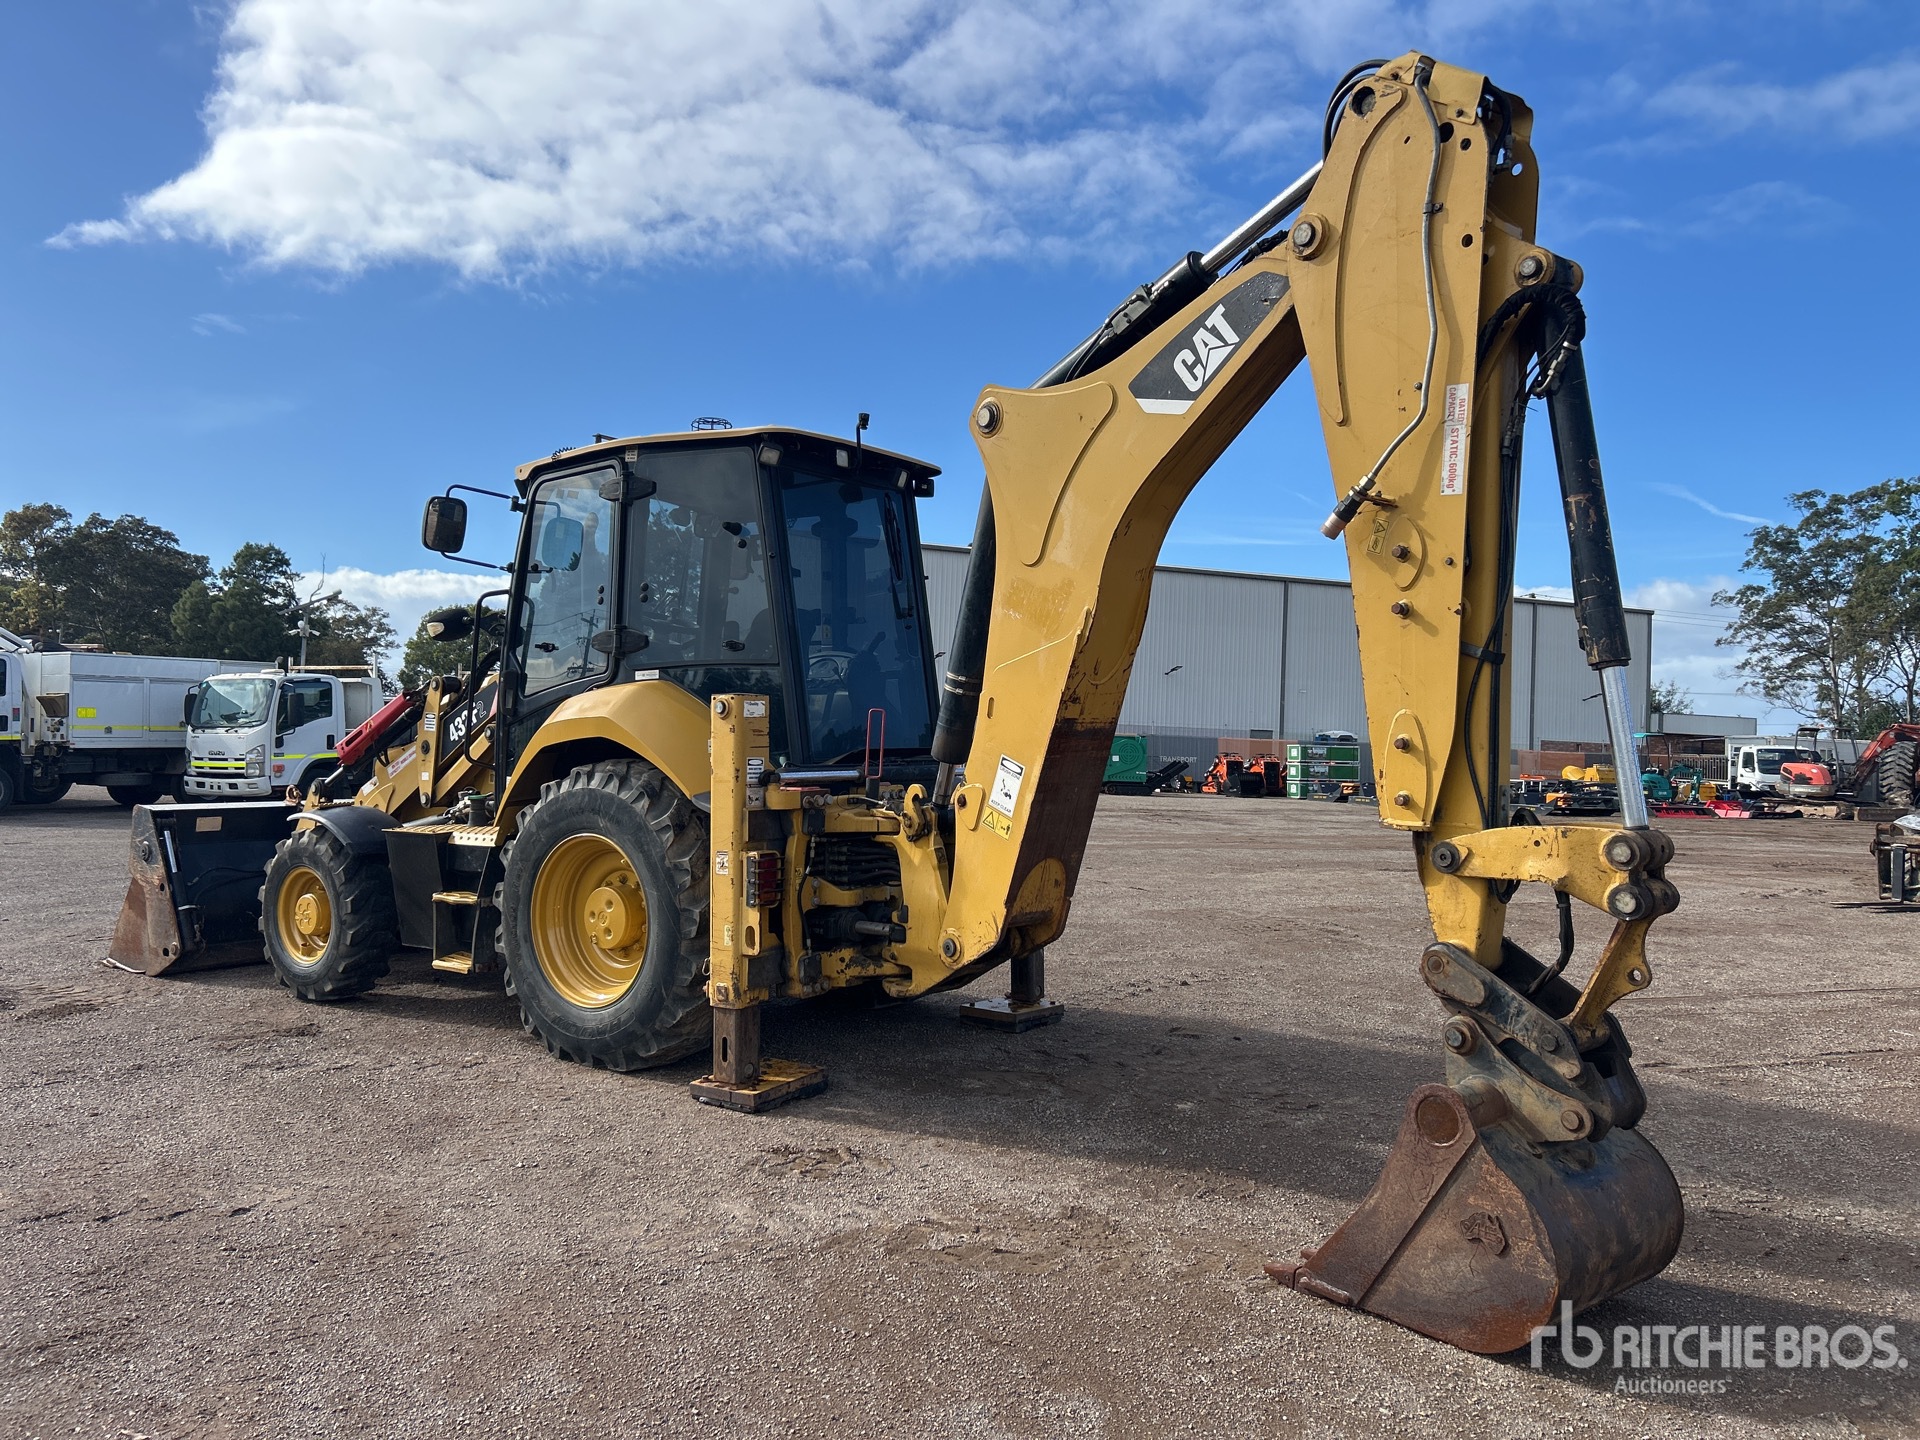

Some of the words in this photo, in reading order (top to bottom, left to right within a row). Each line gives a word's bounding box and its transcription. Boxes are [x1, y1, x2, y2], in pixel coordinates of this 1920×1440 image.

[1173, 303, 1240, 392] CAT
[1447, 387, 1457, 423] CAPACITY
[1458, 398, 1466, 422] RATED
[1160, 755, 1197, 763] TRANSPORT
